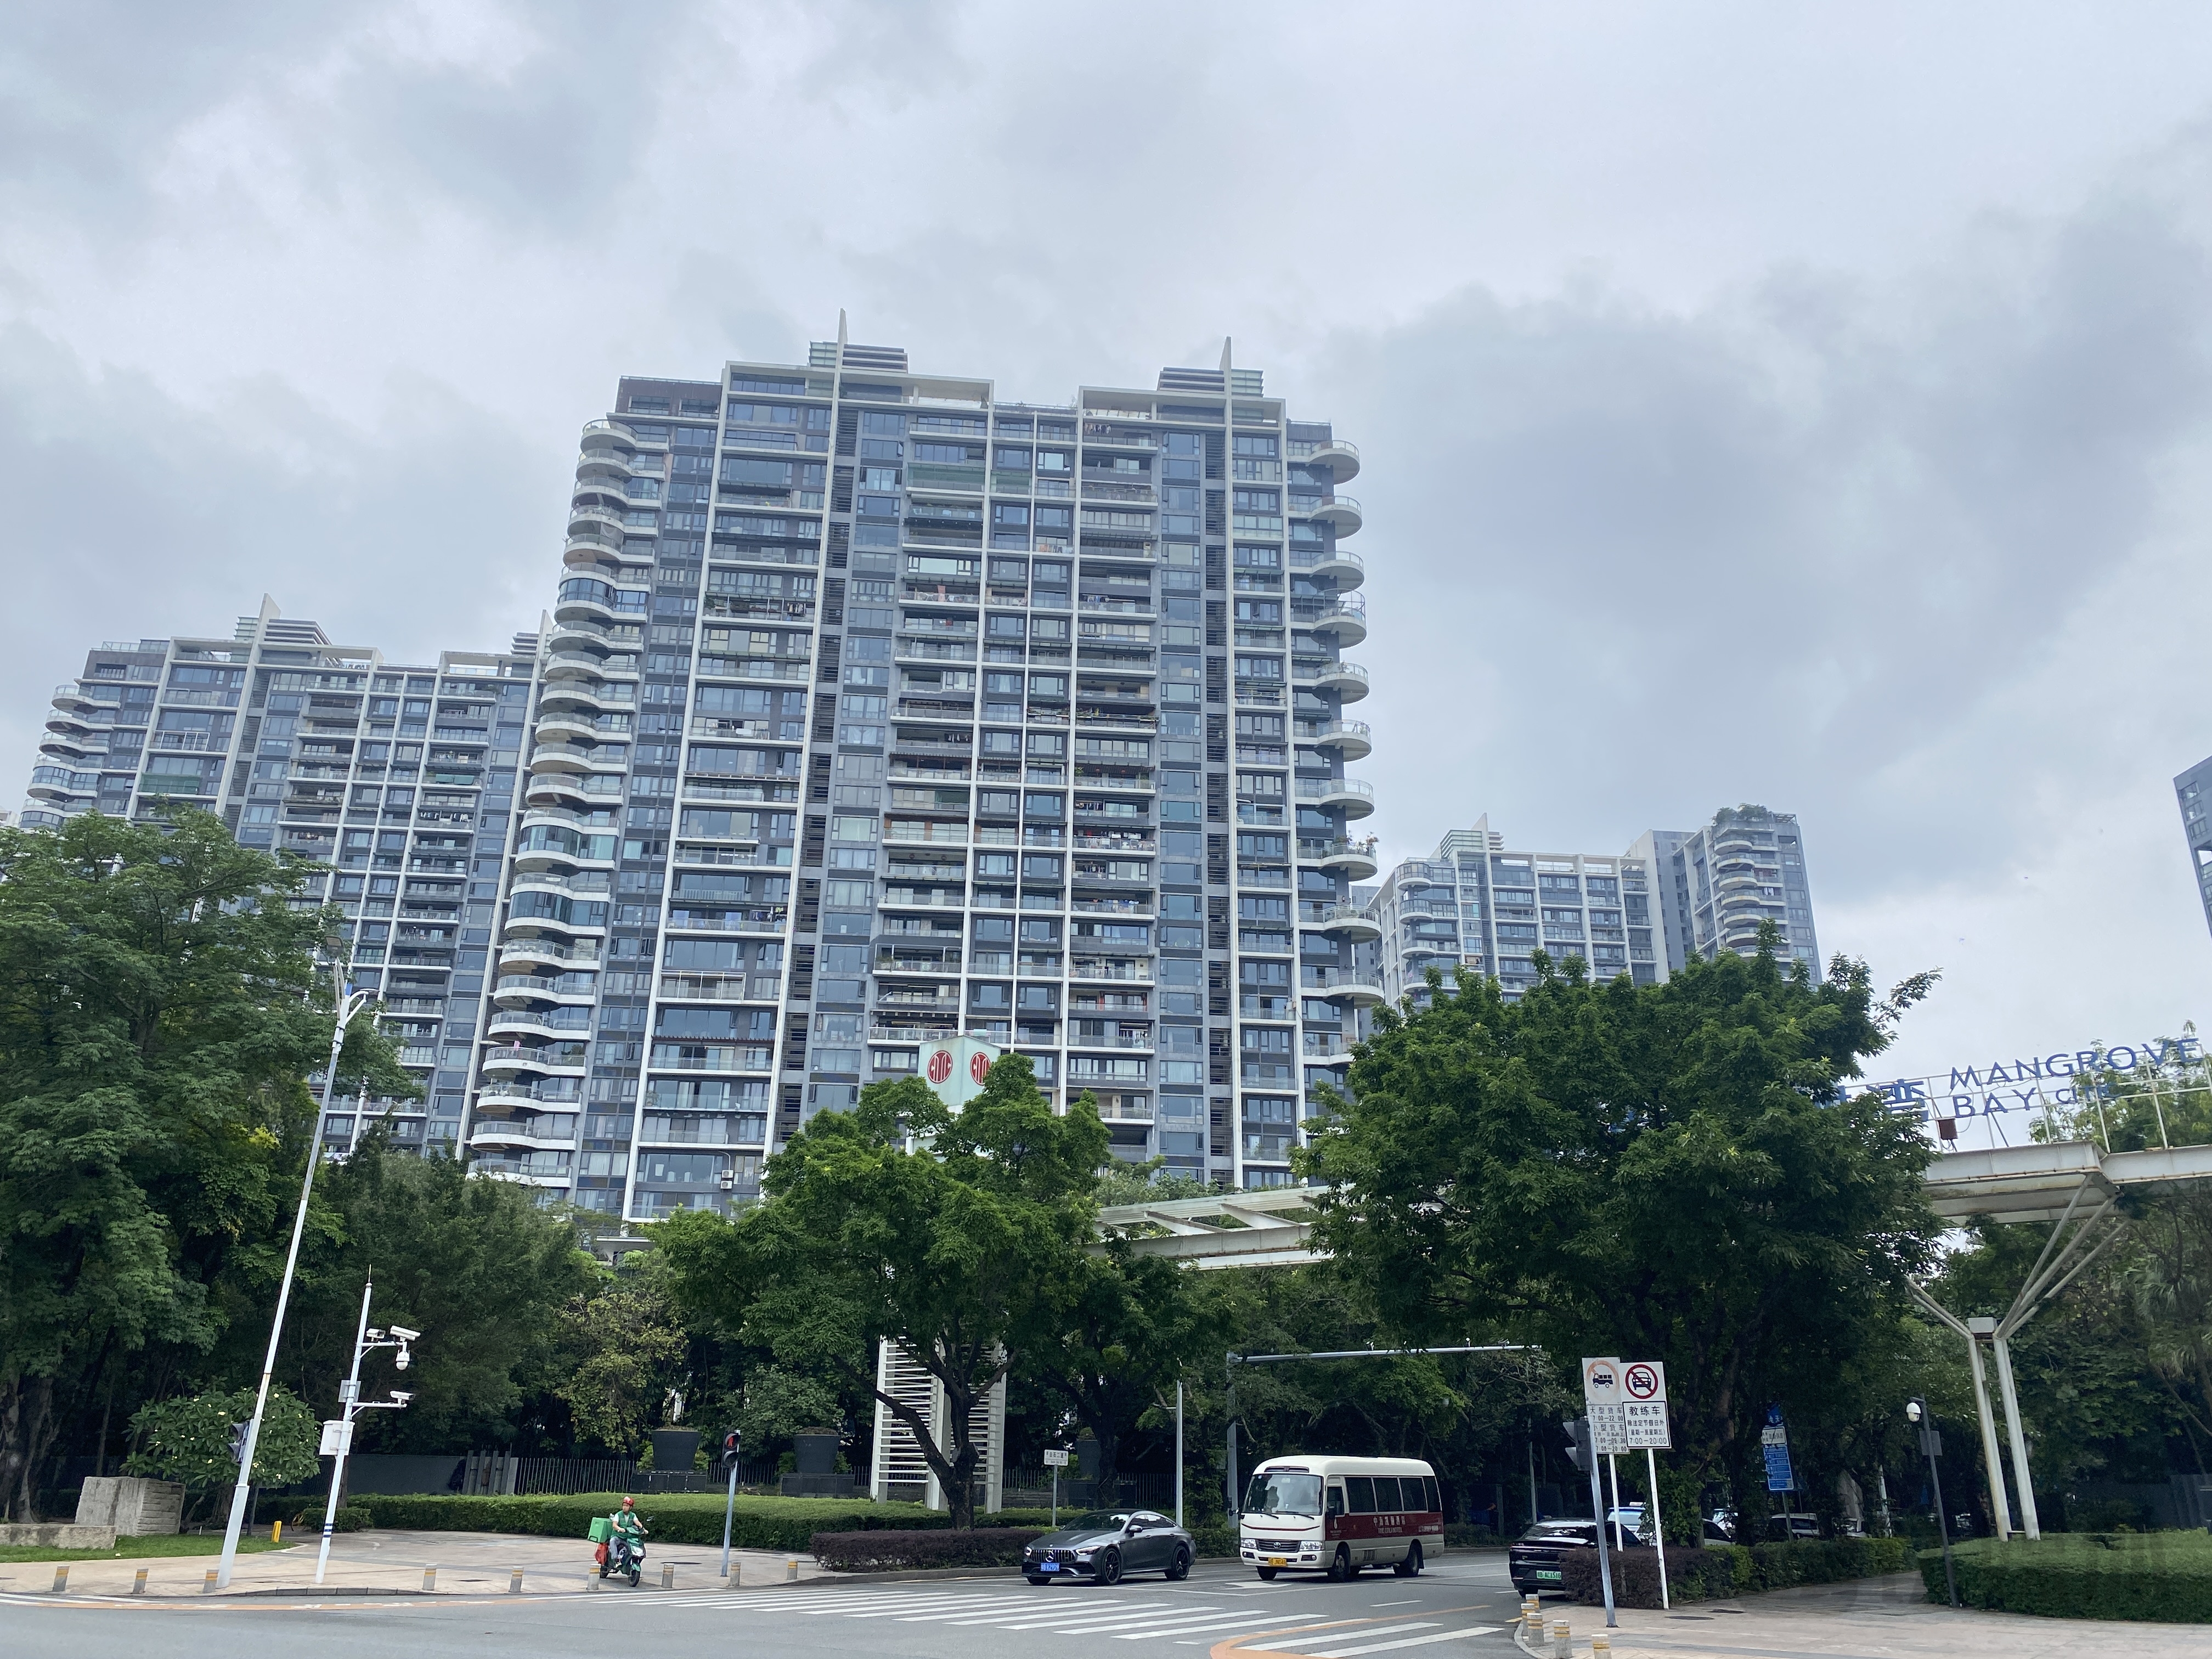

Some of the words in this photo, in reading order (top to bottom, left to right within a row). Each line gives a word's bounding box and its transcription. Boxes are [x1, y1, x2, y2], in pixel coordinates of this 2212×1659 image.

[1950, 1038, 2204, 1090] MANGROVE
[1953, 1087, 2037, 1118] BAY
[1590, 1406, 1622, 1414] 大型货车
[1629, 1406, 1661, 1416] 教练车
